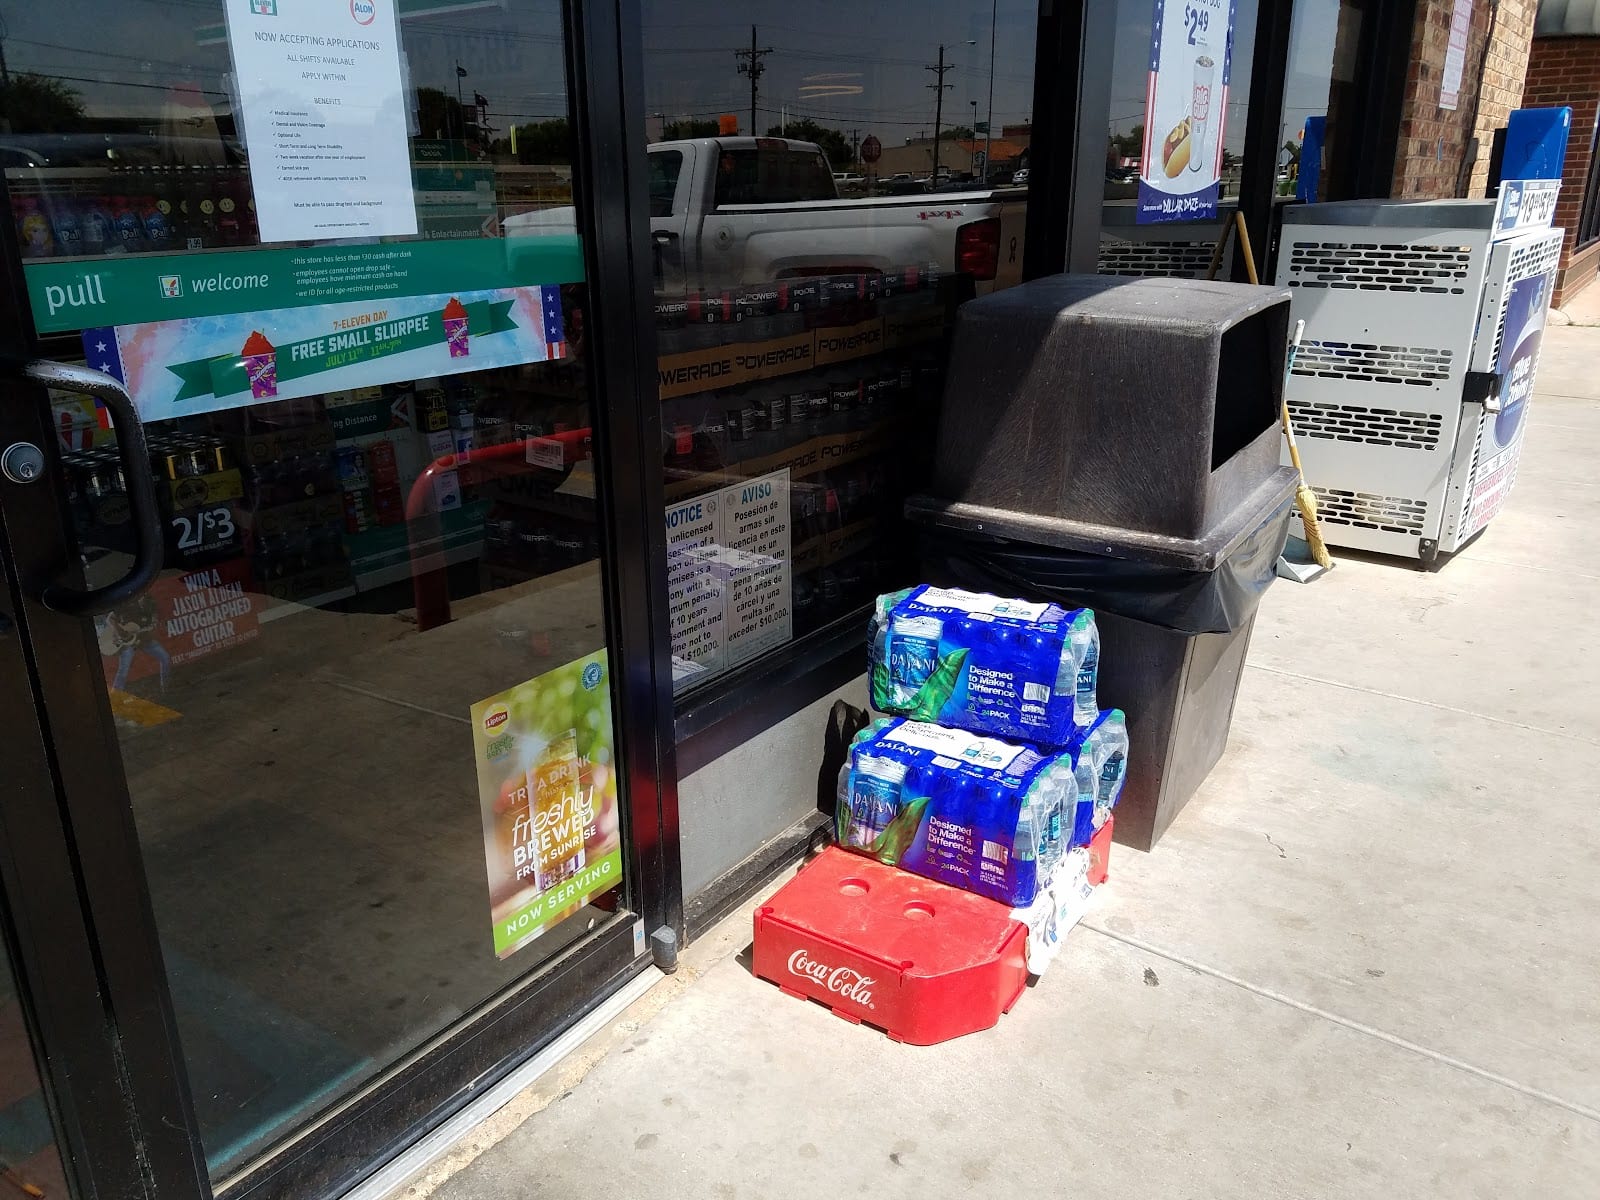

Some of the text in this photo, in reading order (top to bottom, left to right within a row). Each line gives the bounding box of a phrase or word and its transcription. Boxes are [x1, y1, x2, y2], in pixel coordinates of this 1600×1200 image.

[354, 2, 373, 14] ALON
[254, 31, 380, 51] NOW ACCEPTING APPLICATIONS
[287, 54, 355, 66] ALL SHIFTS AVAILABLE
[301, 71, 346, 81] APPLY WITHIN
[431, 228, 480, 240] Entertainment
[294, 257, 306, 265] this
[306, 256, 322, 264] store
[323, 255, 335, 263] has
[386, 252, 400, 260] after
[295, 268, 328, 278] employees
[350, 266, 365, 275] open
[365, 264, 379, 273] drop
[296, 276, 330, 286] employees
[372, 272, 386, 280] cash
[394, 270, 408, 278] hand
[191, 272, 270, 294] welcome
[316, 288, 326, 297] for
[326, 287, 334, 295] all
[374, 282, 399, 292] products
[44, 273, 107, 317] pull
[332, 310, 389, 331] 7-ELEVEN DAY
[291, 315, 430, 362] FREE SMALL SLURPEE
[818, 327, 882, 353] POWERADE
[325, 352, 348, 368] JULY
[735, 343, 811, 371] POWERADE
[345, 413, 378, 427] Distance
[741, 481, 772, 505] AVISO
[664, 503, 702, 529] NOTICE
[734, 500, 779, 523] Posesión de
[171, 507, 236, 550] 2/$3
[670, 521, 713, 544] unlicensed
[739, 514, 775, 535] armas sin
[700, 536, 708, 548] of
[709, 536, 714, 544] a
[728, 524, 786, 550] licencia en este
[758, 544, 767, 553] es
[768, 539, 777, 549] un
[772, 549, 785, 560] una
[706, 566, 711, 574] a
[184, 568, 222, 594] WIN A
[686, 580, 703, 594] with
[733, 575, 752, 591] pena
[733, 575, 783, 602] de 10 años de
[172, 580, 244, 617] JASON ALDEAN
[692, 588, 720, 608] penalty
[736, 588, 780, 613] cárcel y una
[907, 602, 954, 615] DASANI
[166, 596, 252, 639] AUTOGRAPHED
[676, 614, 686, 626] 10
[688, 606, 708, 624] years
[707, 612, 722, 626] and
[741, 602, 776, 624] multa sin
[192, 620, 236, 648] GUITAR
[728, 607, 789, 642] exceder $10,000.
[689, 634, 702, 647] not
[703, 631, 712, 640] to
[687, 639, 720, 661] $10,000.
[890, 650, 936, 673] DASANI
[968, 664, 1014, 682] Designed
[968, 674, 1014, 690] to Make a
[967, 682, 1016, 698] Difference
[485, 711, 508, 729] Lipton
[875, 740, 921, 757] DASANI
[537, 778, 548, 792] A
[548, 752, 592, 785] DRINK
[511, 782, 596, 848] freshly
[854, 792, 899, 817] DASANI
[512, 806, 596, 869] BREWED
[928, 825, 972, 846] to Make a
[929, 816, 972, 838] Designed
[515, 824, 597, 882] FROM SUNRISE
[927, 834, 976, 856] Difference
[505, 860, 612, 937] NOW SERVING
[786, 948, 877, 1007] Coca-Cola
